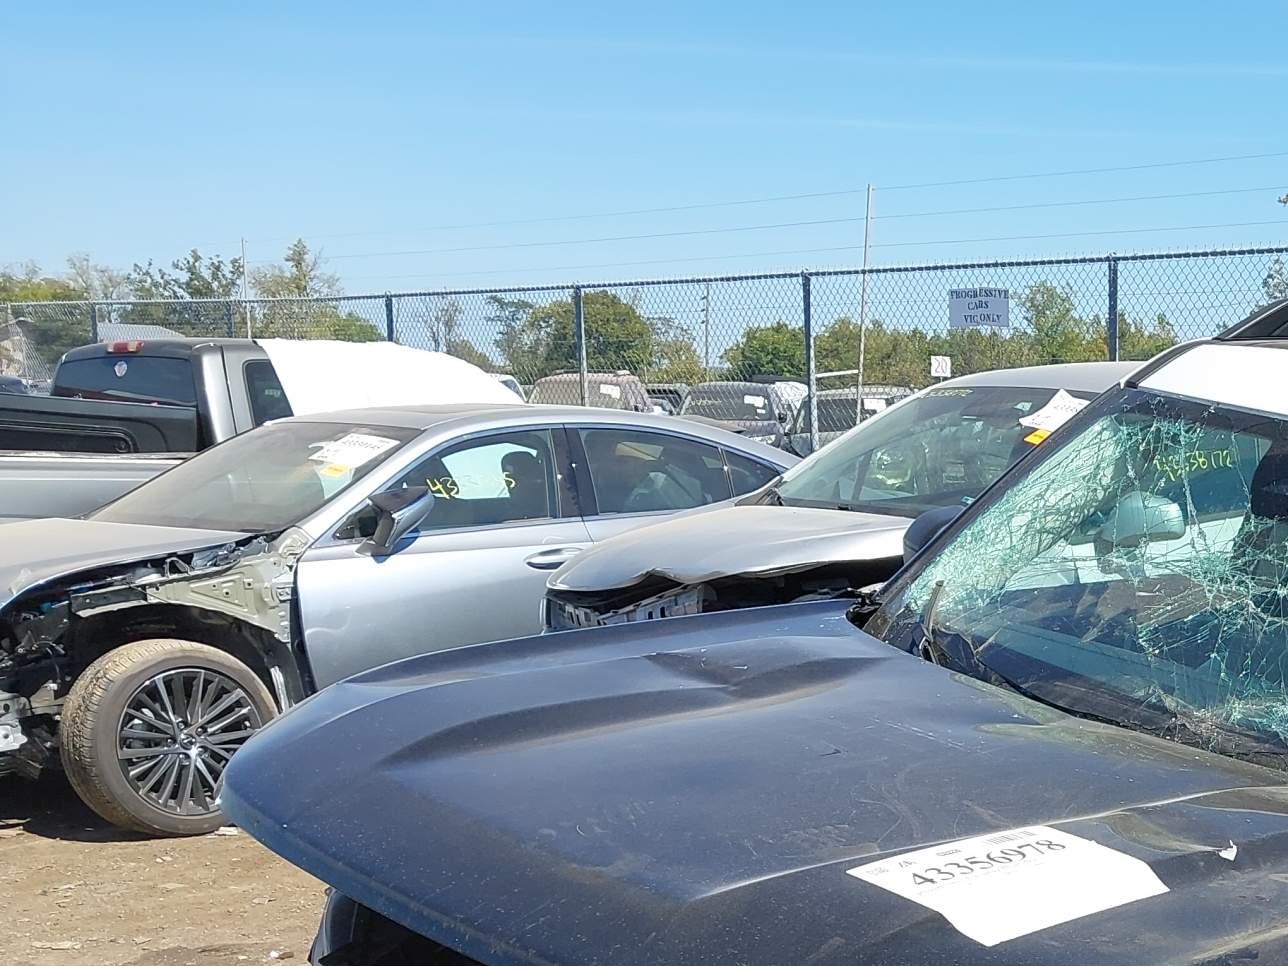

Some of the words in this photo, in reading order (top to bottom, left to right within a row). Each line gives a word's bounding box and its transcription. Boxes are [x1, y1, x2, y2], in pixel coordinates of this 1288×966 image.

[967, 300, 989, 310] CARS
[979, 313, 1002, 323] ONLY
[934, 357, 948, 374] 20
[912, 839, 1067, 886] 43356978
